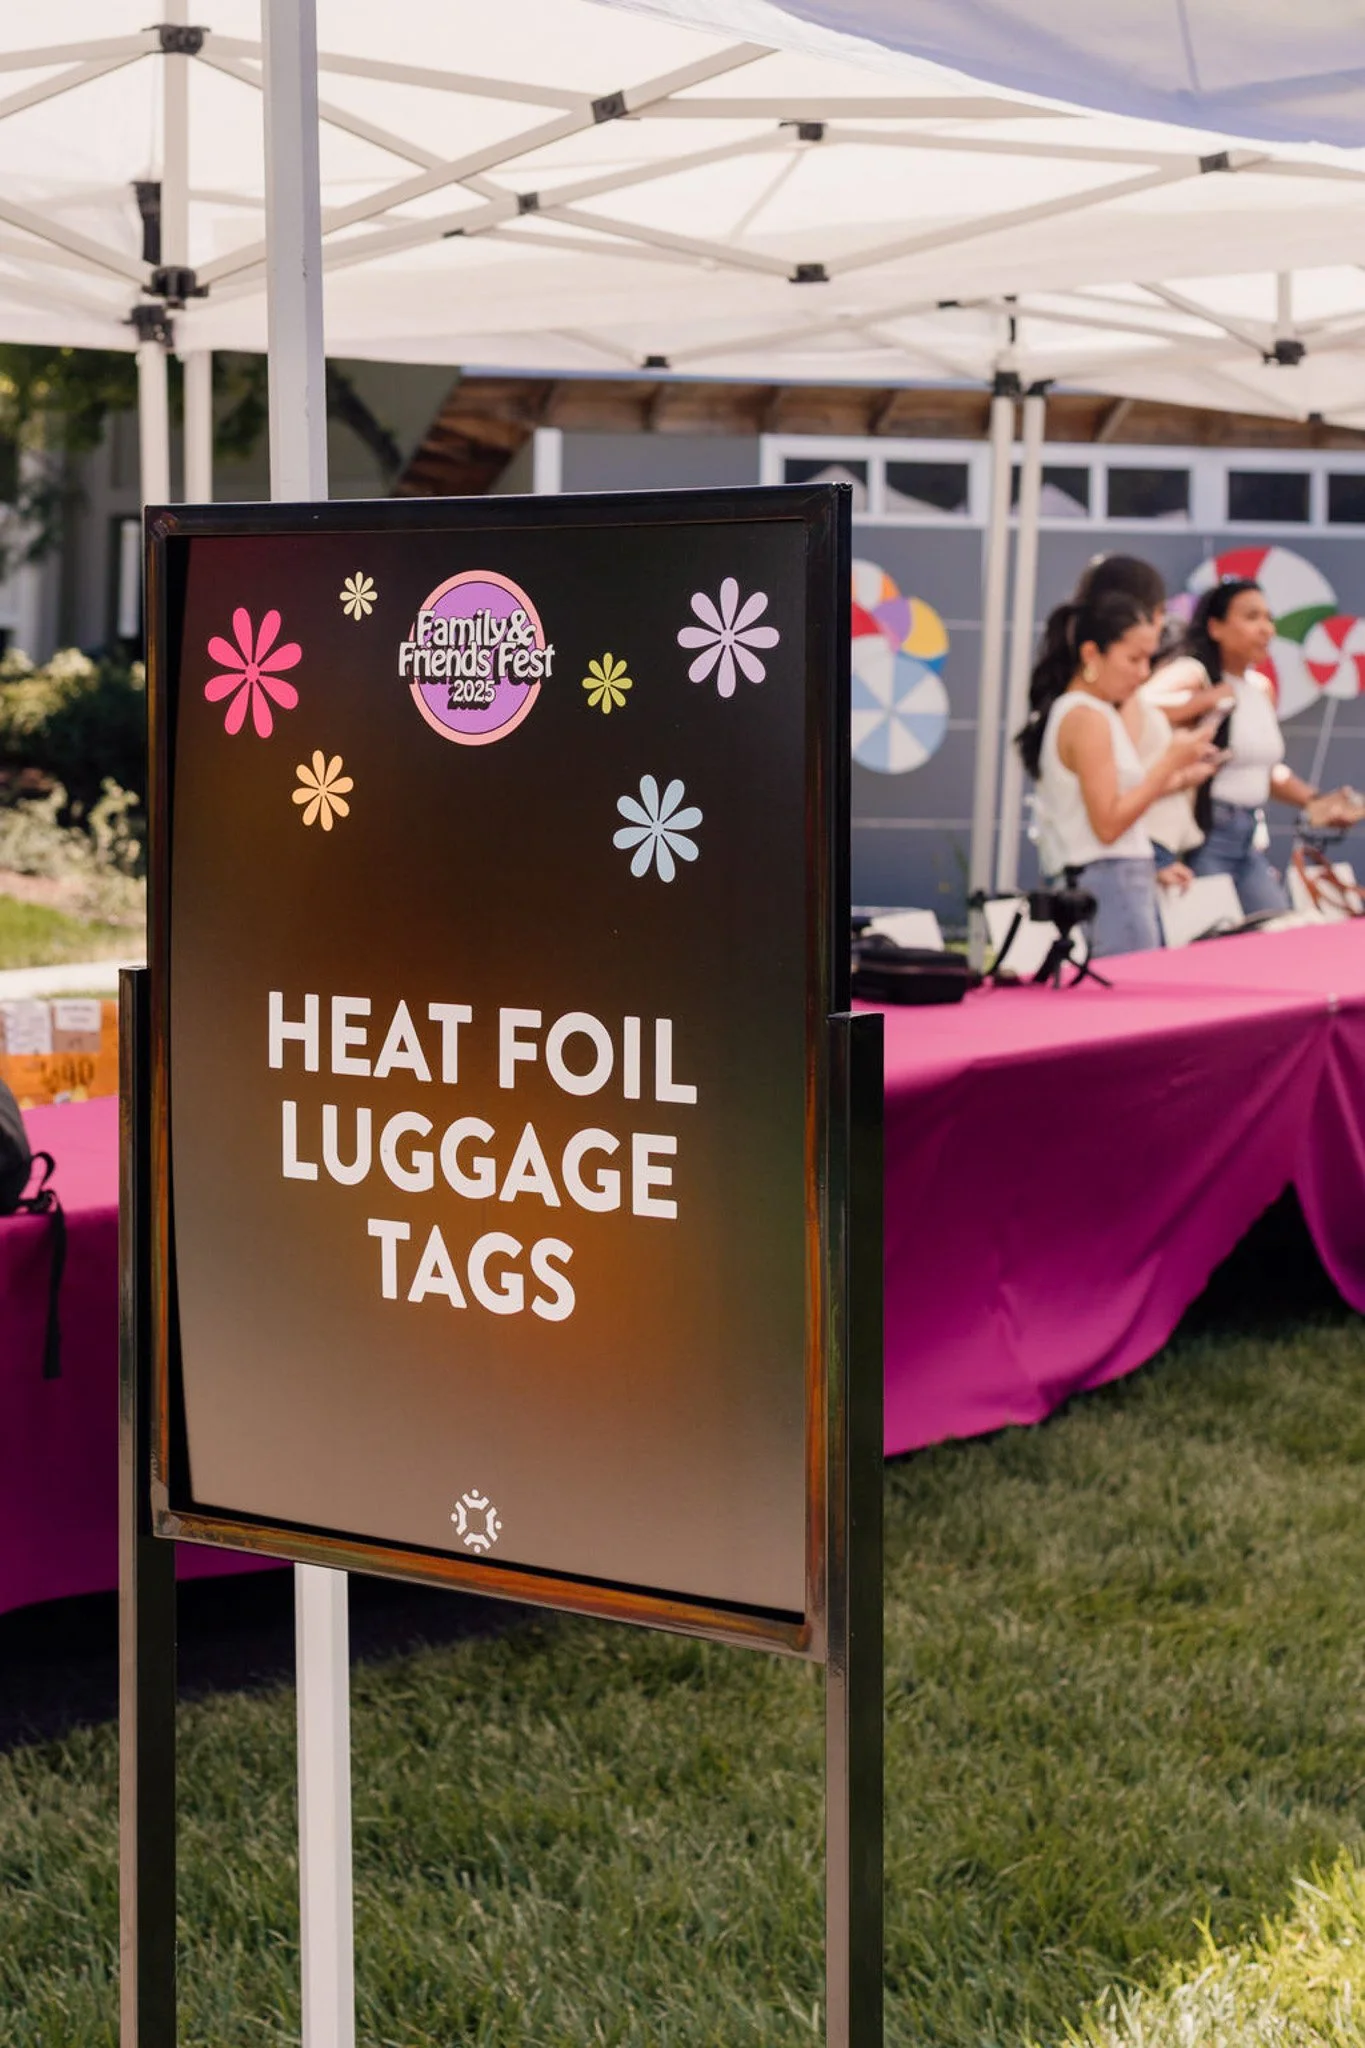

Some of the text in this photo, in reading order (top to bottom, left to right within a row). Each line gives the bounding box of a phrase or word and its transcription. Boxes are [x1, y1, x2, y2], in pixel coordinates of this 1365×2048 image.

[398, 641, 556, 680] Friends Fest
[452, 679, 496, 704] 2025
[268, 991, 697, 1104] HEAT FOIL
[282, 1100, 677, 1219] LUGGAGE
[367, 1218, 575, 1322] TAGS
